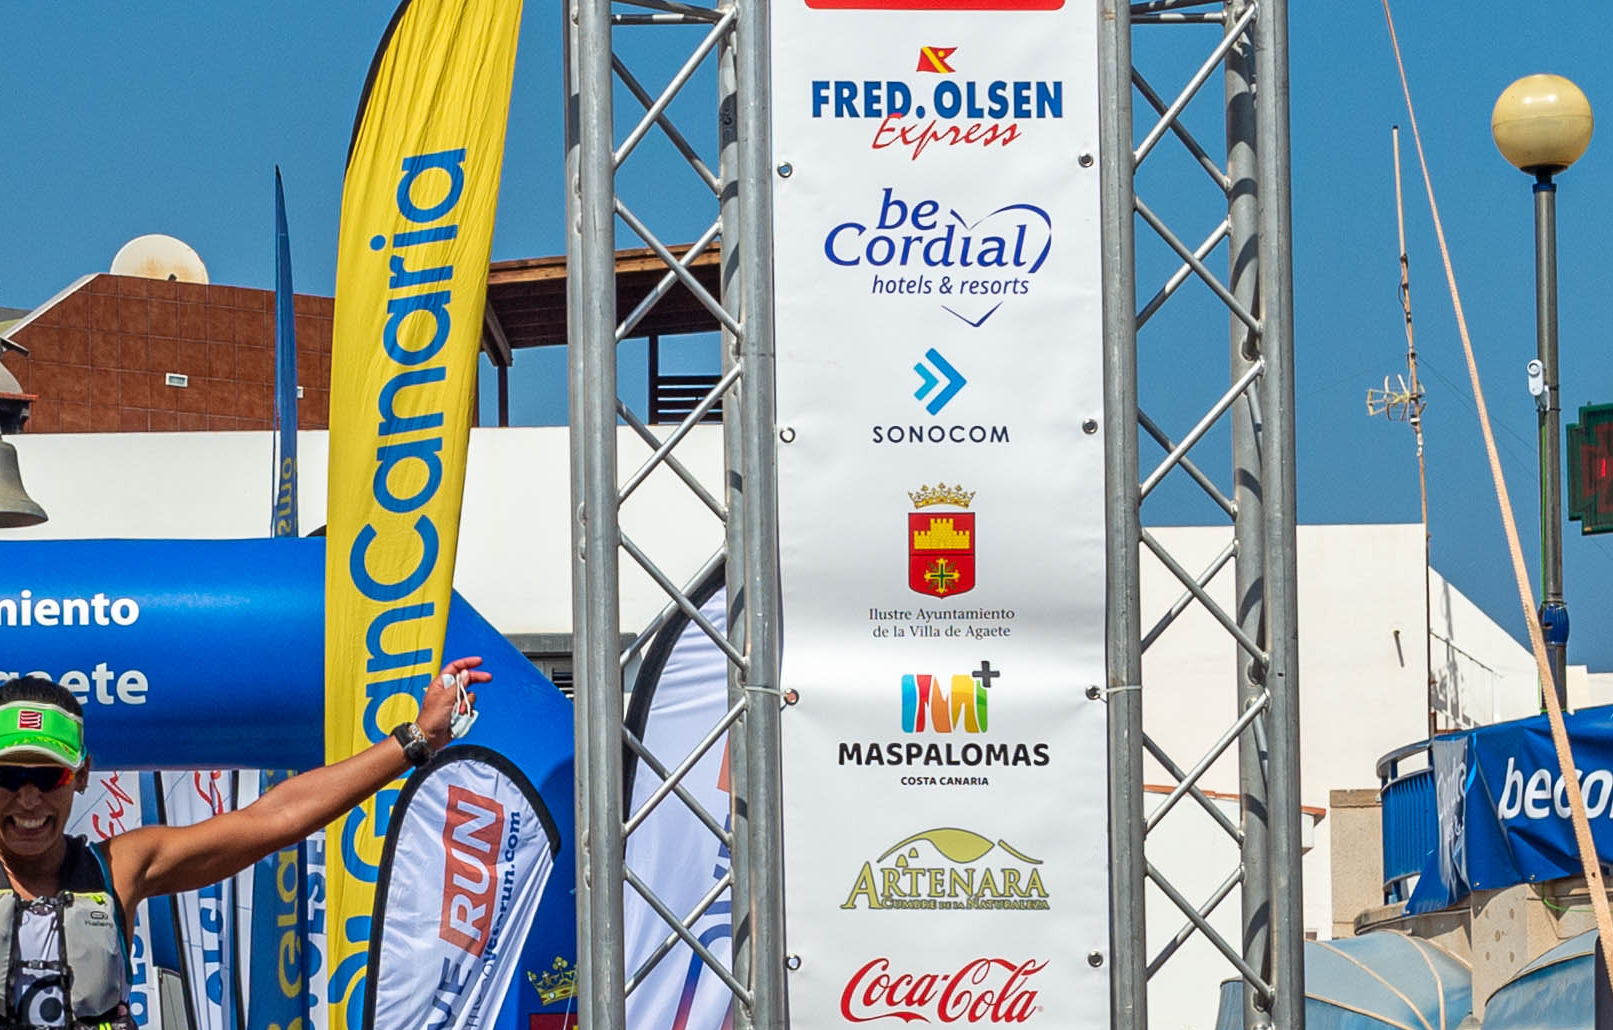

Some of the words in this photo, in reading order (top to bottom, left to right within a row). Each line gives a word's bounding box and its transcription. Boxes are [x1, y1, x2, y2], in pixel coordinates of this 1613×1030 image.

[872, 113, 1021, 161] Express
[876, 187, 939, 230] be
[824, 222, 1028, 267] Cordial
[872, 275, 932, 295] hotels
[939, 276, 953, 295] &
[960, 276, 1029, 295] resorts
[872, 425, 1010, 444] SONOCOM
[869, 607, 912, 621] Ilustre
[916, 607, 1015, 623] Ayuntamiento
[872, 625, 890, 638] de
[893, 625, 905, 638] la
[908, 625, 941, 638] Villa
[944, 625, 961, 638] de
[964, 625, 1011, 640] Agaete
[838, 742, 1050, 767] MASPALOMAS
[901, 776, 937, 786] COSTA
[939, 776, 989, 786] CANARIA
[450, 800, 497, 942] RUN
[840, 861, 1050, 910] ARTENARA
[840, 958, 1050, 1024] Coca-Cola
